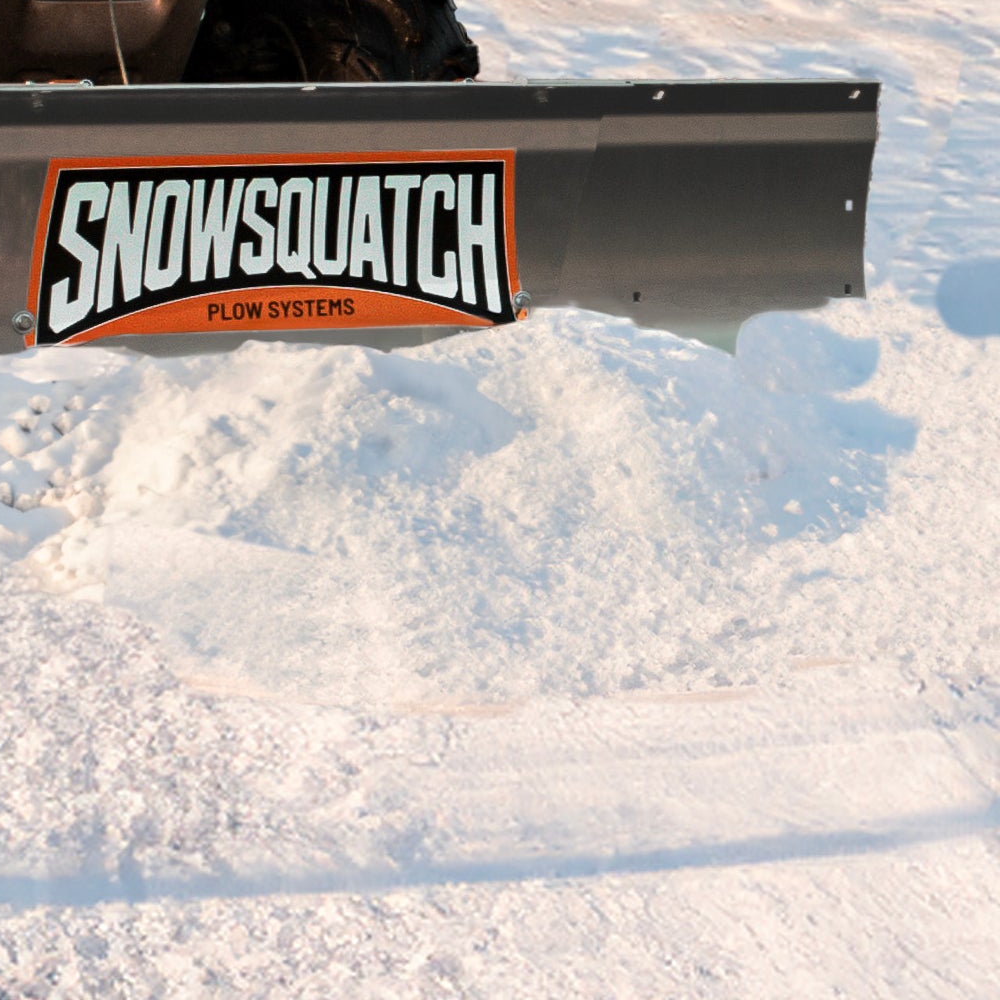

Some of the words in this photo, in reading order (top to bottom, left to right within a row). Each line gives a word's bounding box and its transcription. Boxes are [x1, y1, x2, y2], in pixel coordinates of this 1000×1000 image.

[48, 173, 502, 334] SNOWSQUATCH
[207, 302, 263, 321] PLOW
[268, 298, 355, 319] SYSTEMS
